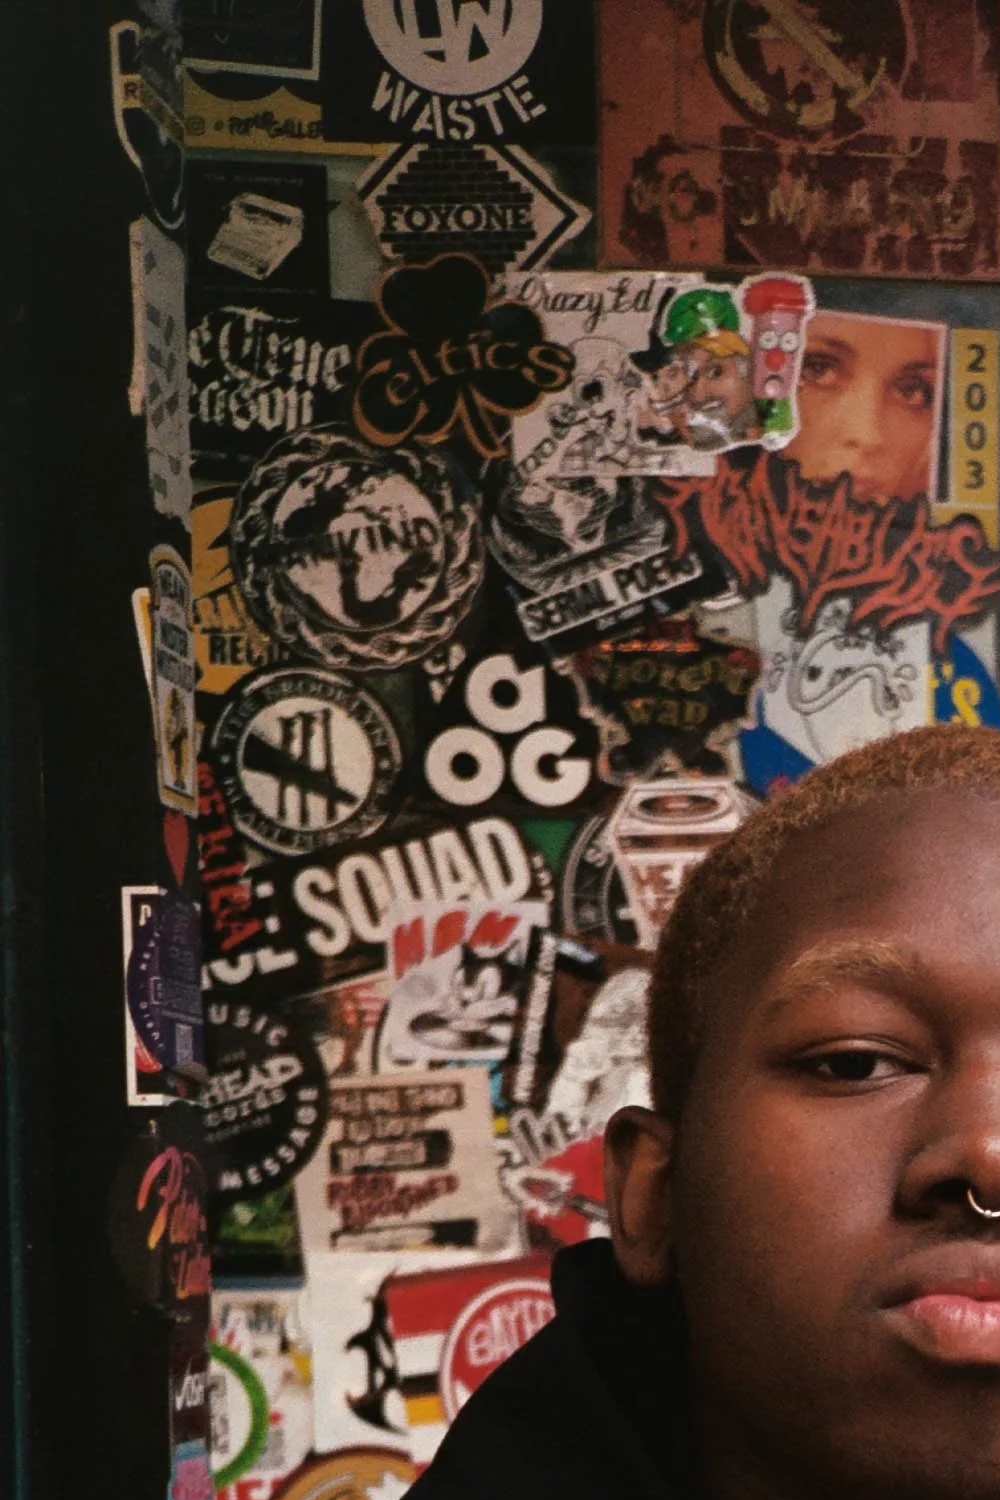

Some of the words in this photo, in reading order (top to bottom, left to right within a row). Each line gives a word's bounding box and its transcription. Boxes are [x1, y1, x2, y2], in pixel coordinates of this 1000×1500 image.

[371, 71, 548, 141] WASTE
[383, 205, 533, 232] FOYONE
[352, 328, 572, 447] Celtics
[963, 342, 990, 491] 2003
[293, 816, 532, 957] SQUAD
[207, 1002, 289, 1047] USIC
